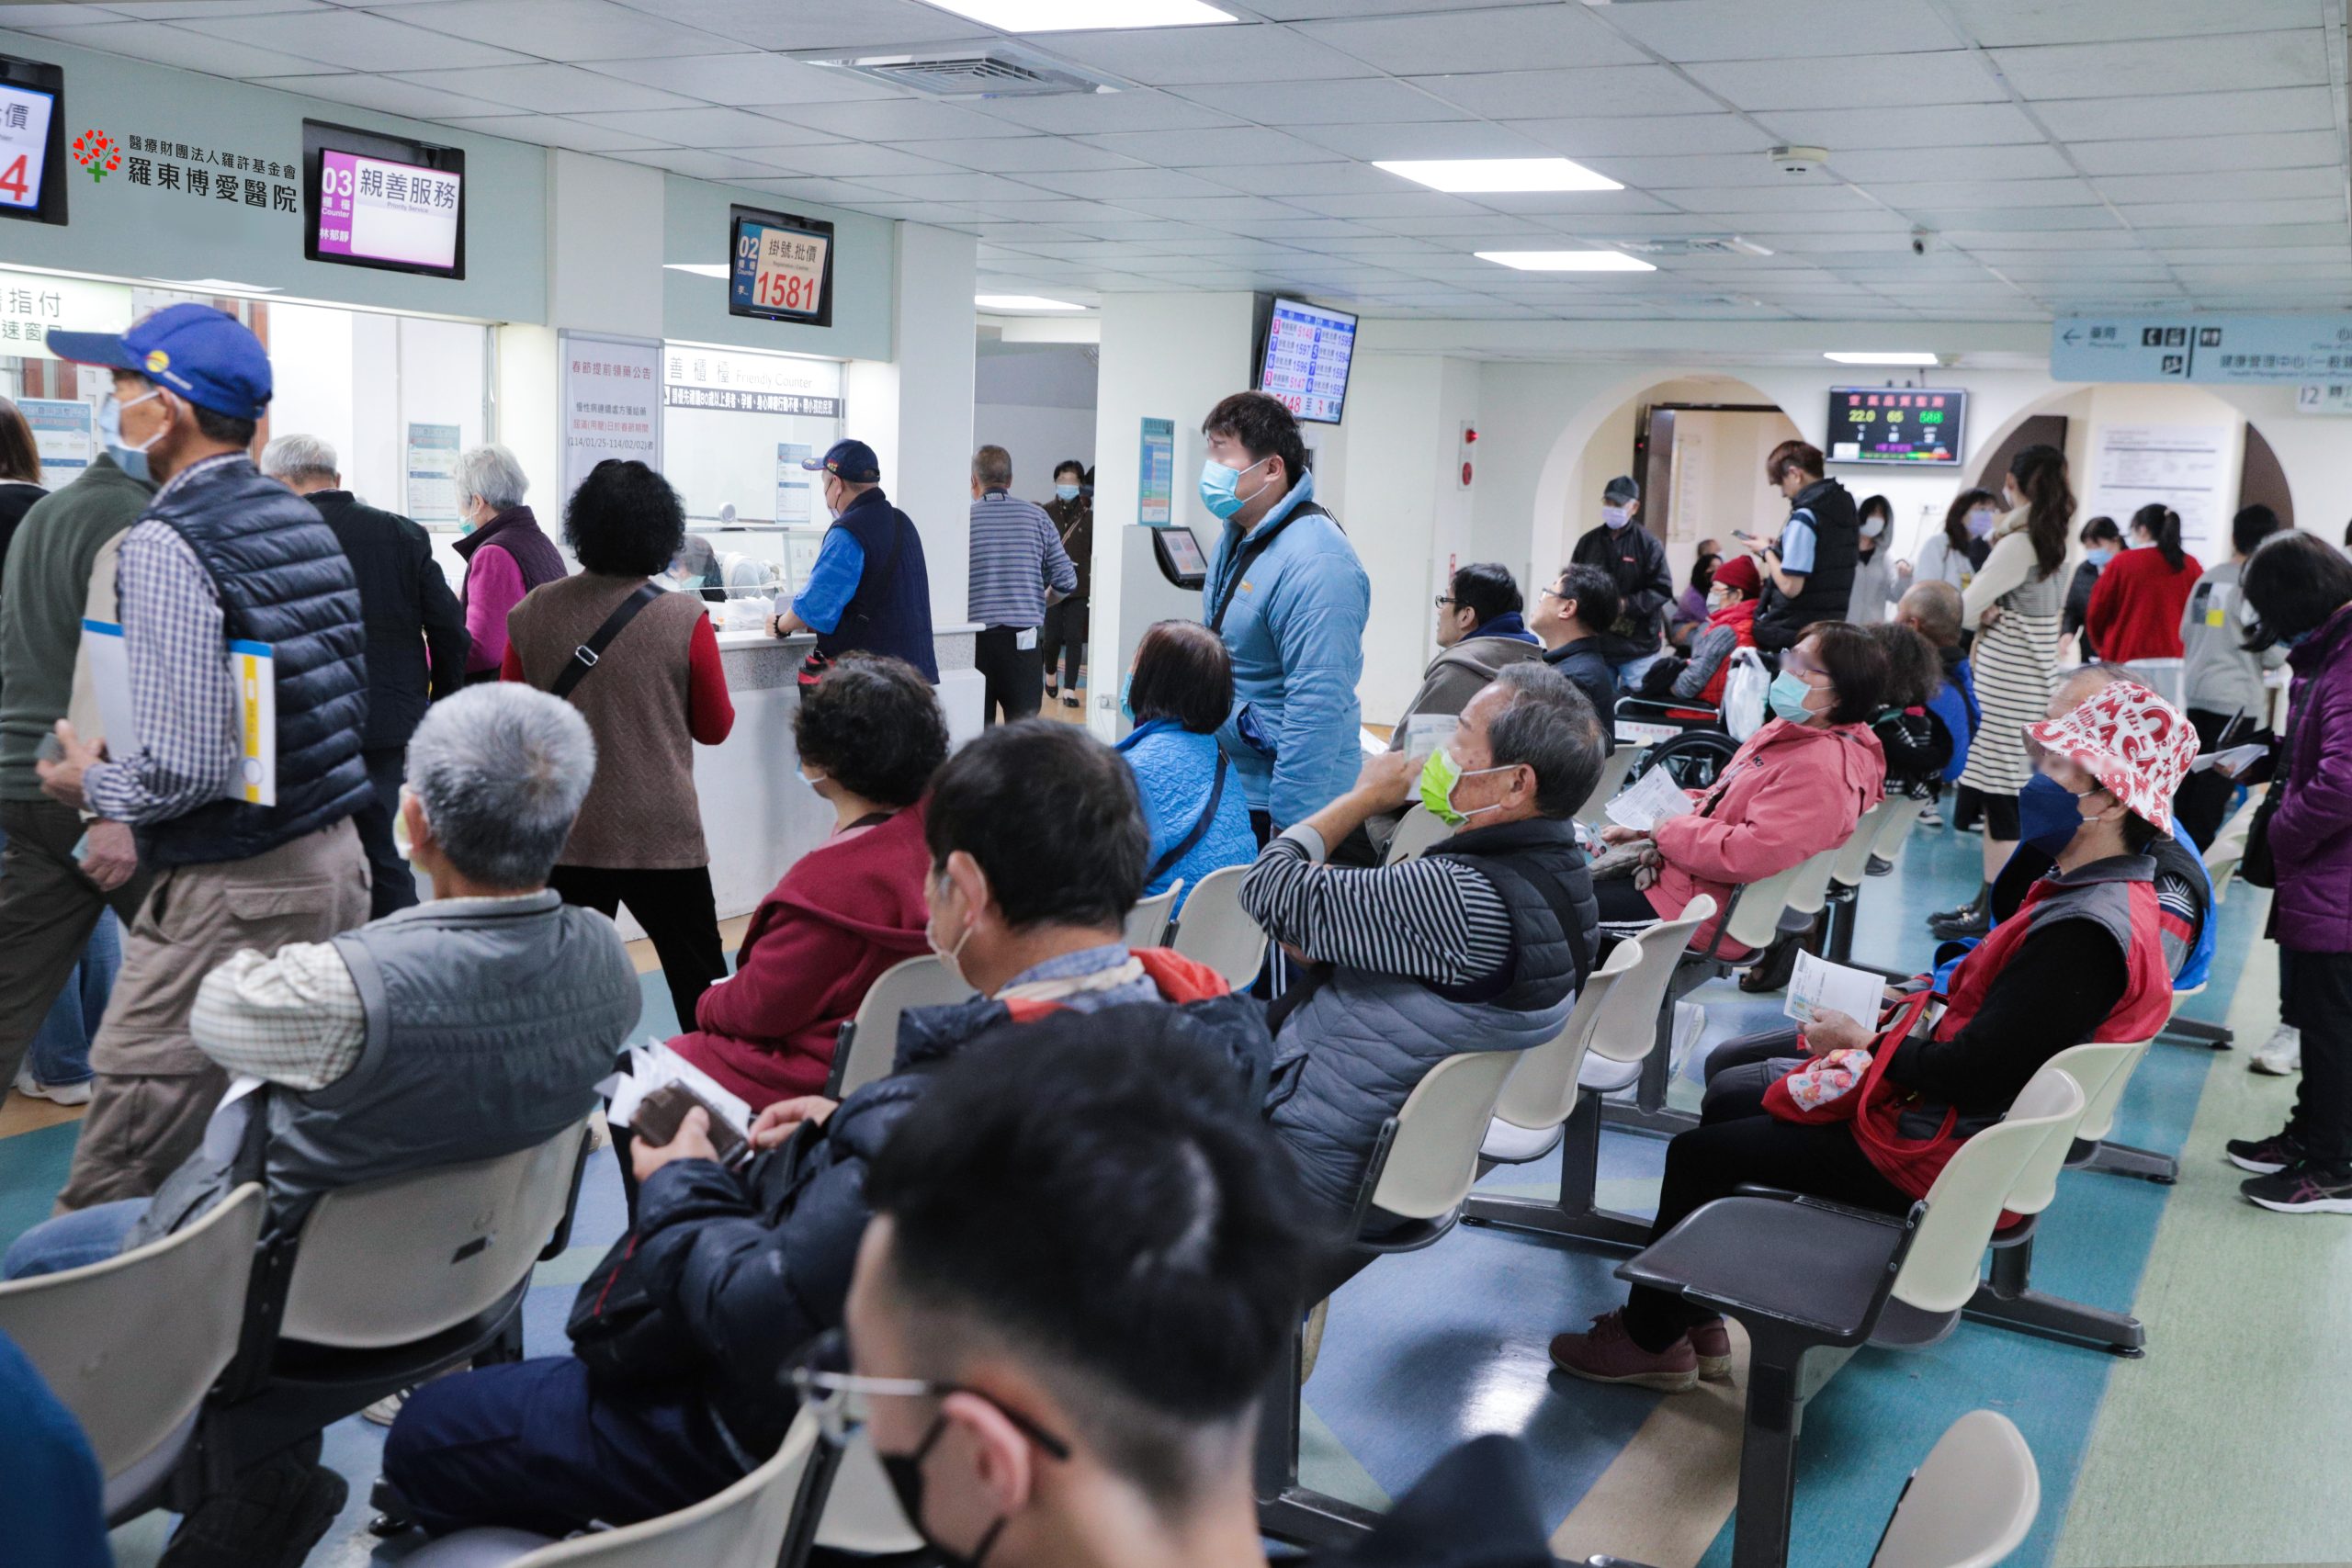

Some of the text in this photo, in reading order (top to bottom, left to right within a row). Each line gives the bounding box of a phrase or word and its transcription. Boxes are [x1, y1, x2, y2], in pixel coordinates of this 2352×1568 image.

[0, 102, 29, 130] 價
[129, 134, 296, 180] 醫療財團法人羅許基金會
[128, 156, 297, 213] 羅東博愛醫院
[322, 167, 353, 197] 03
[360, 168, 456, 209] 親善服務
[322, 208, 350, 219] Counter
[408, 205, 428, 214] Service
[739, 235, 759, 259] 02
[758, 271, 814, 310] 1581
[0, 288, 62, 318] 指付
[1295, 343, 1311, 355] 1597
[572, 361, 650, 379] 春節提前領藥公告
[736, 369, 812, 389] Friendly Counter
[2300, 387, 2320, 404] 12
[1849, 410, 1876, 423] 22.0
